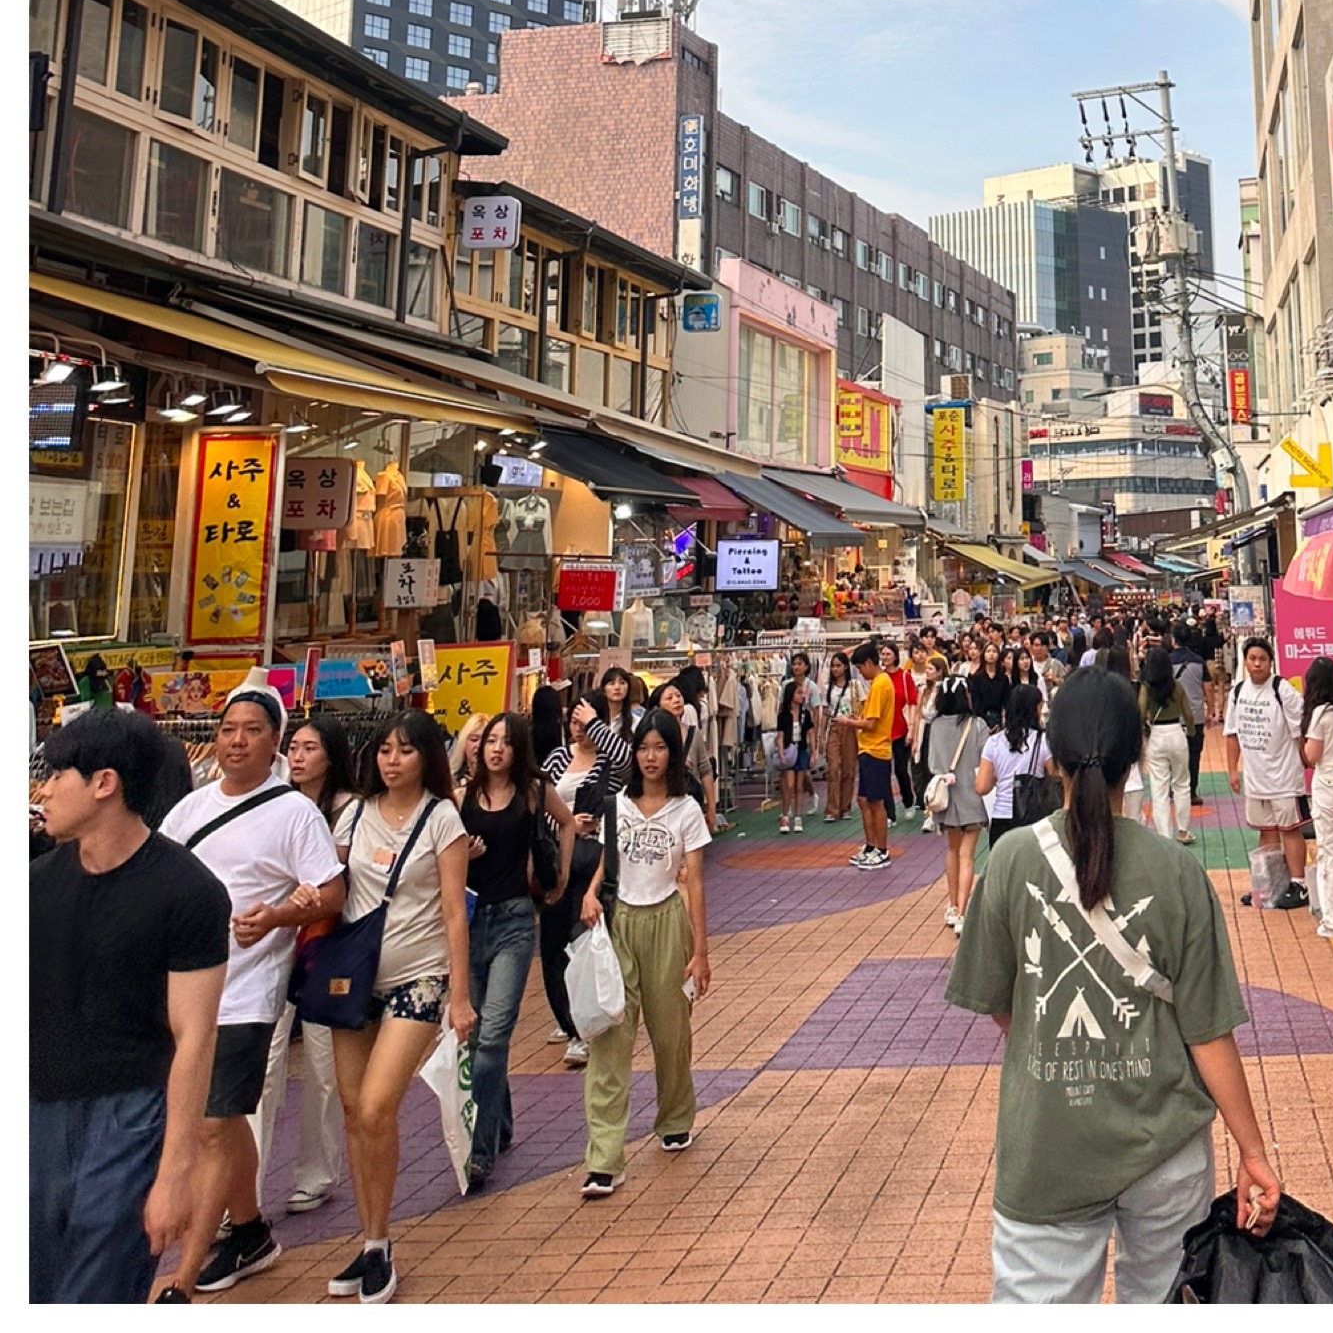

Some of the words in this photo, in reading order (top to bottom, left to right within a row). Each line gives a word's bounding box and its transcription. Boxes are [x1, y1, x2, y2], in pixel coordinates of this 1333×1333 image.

[682, 136, 701, 215] 호미화방
[470, 204, 509, 221] 옥상
[469, 226, 507, 243] 포차
[210, 458, 266, 483] 사주
[287, 467, 337, 491] 옥상
[227, 492, 242, 509] &
[286, 500, 336, 520] 포차
[204, 520, 259, 546] 타로
[728, 547, 768, 558] Piercing
[732, 566, 762, 576] Tattoo
[439, 659, 499, 686] 사주
[457, 699, 473, 715] &
